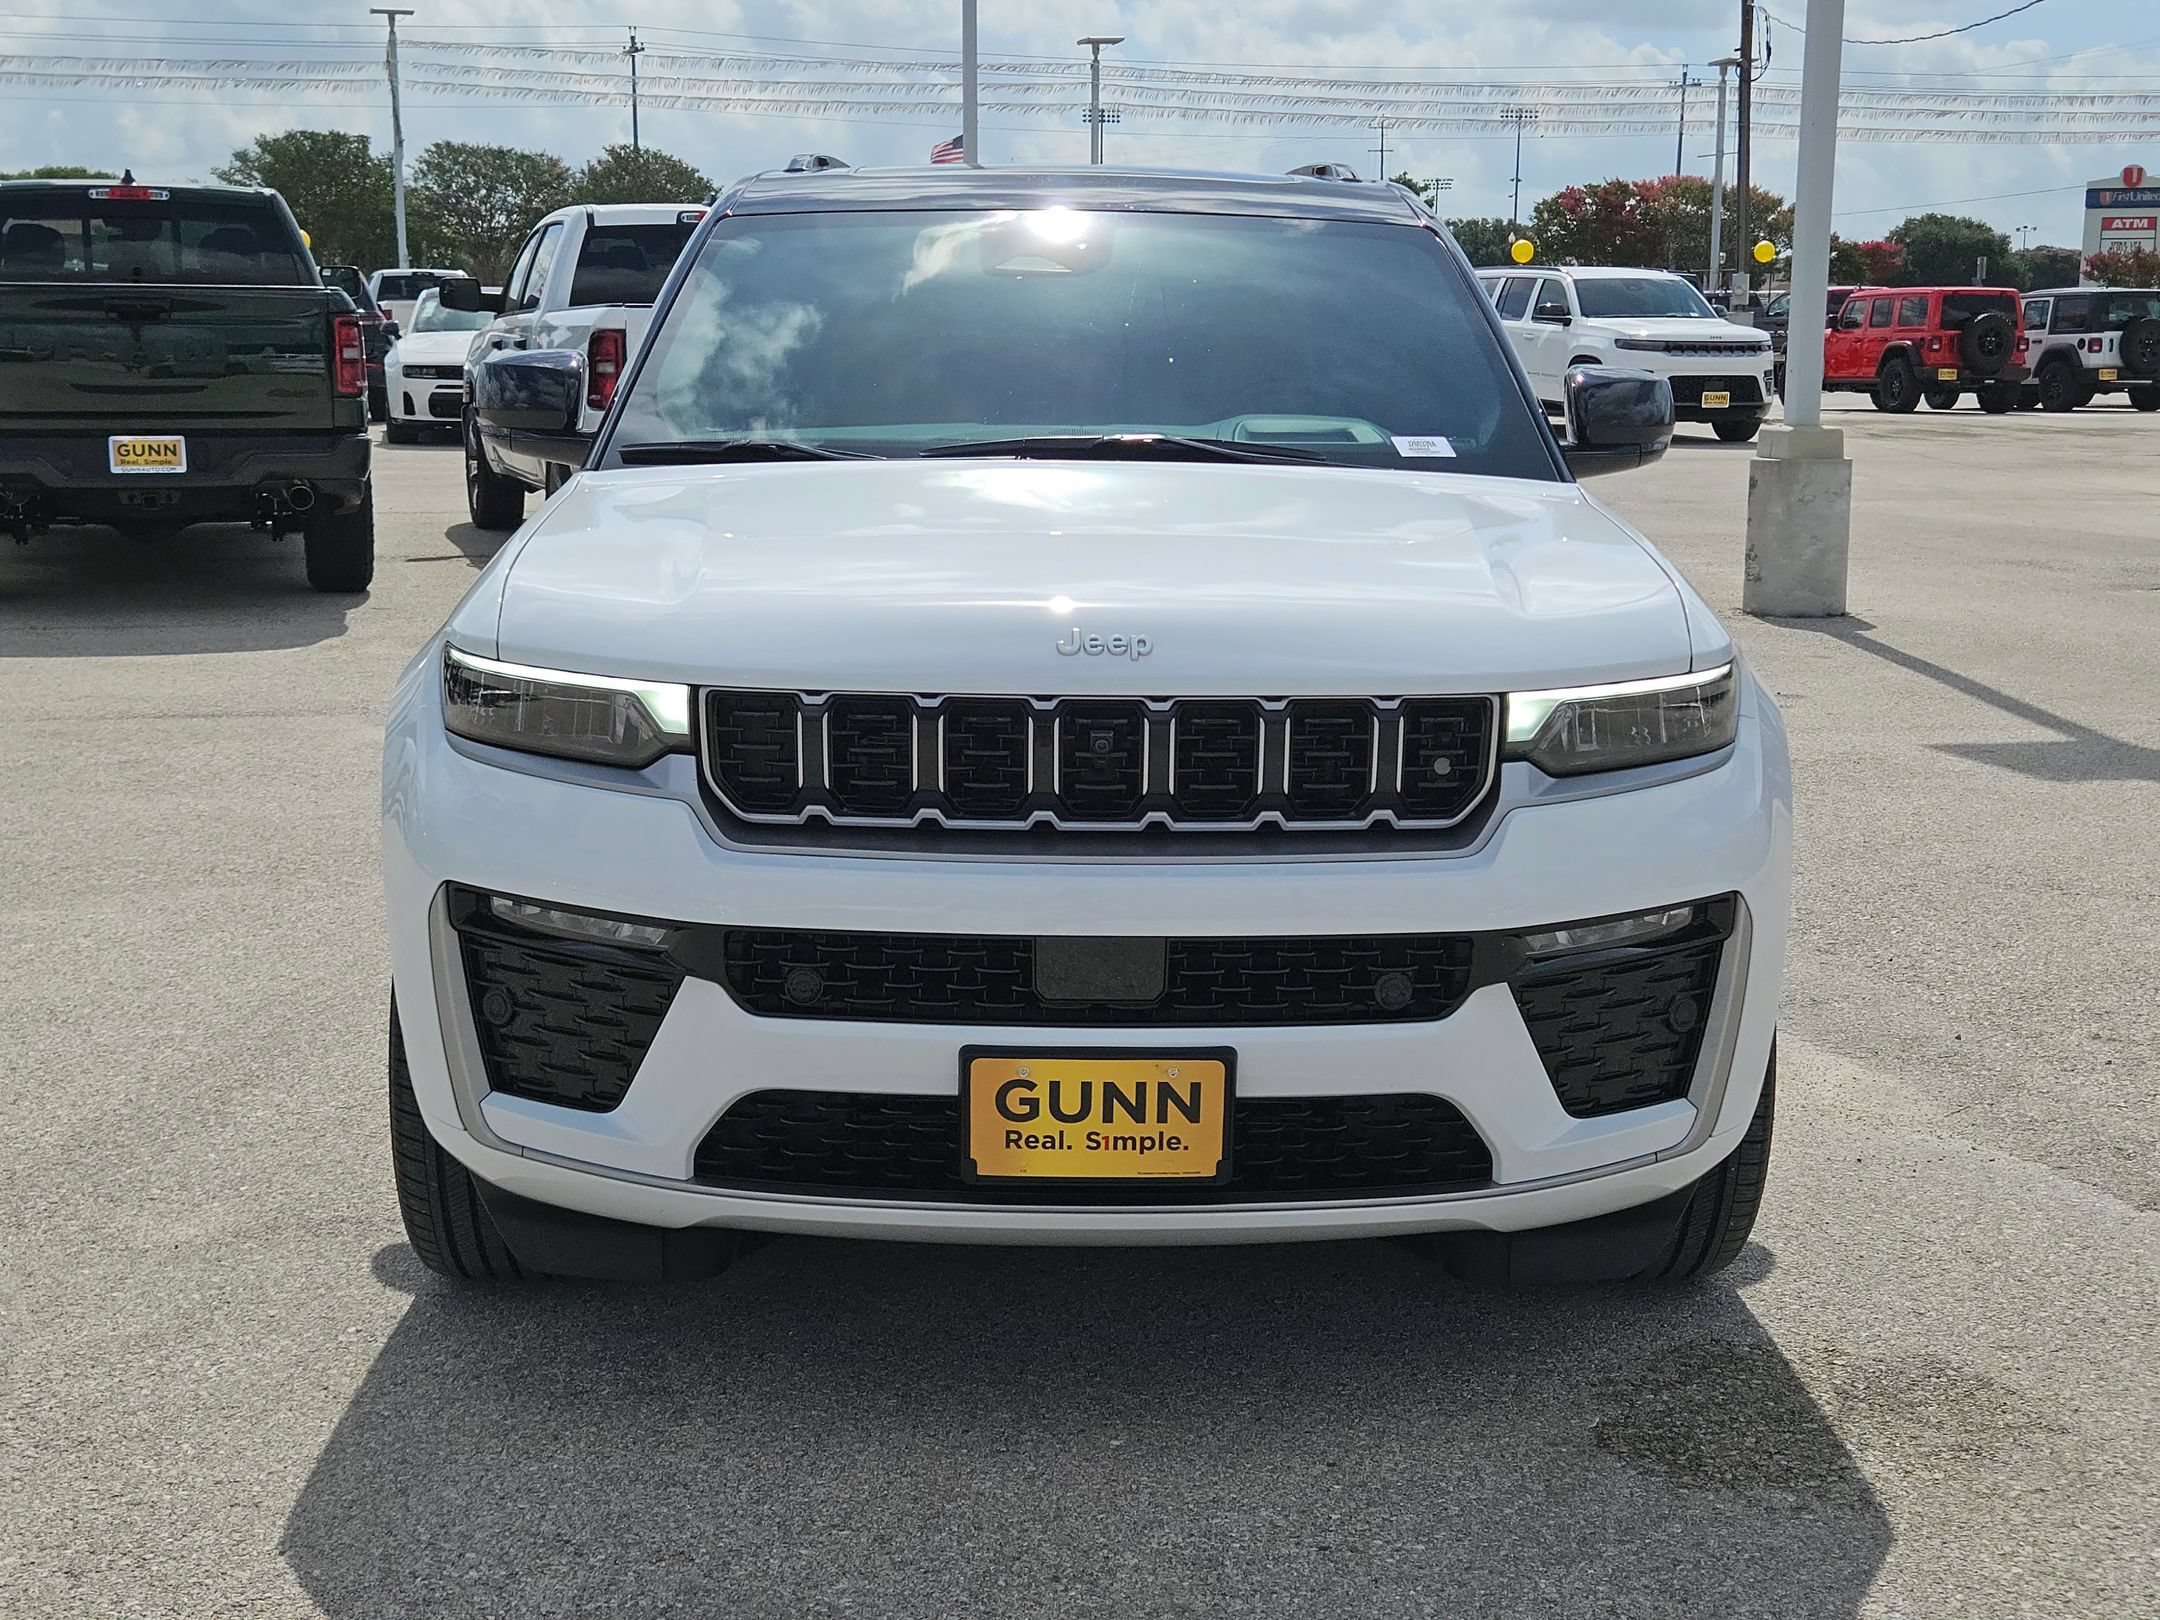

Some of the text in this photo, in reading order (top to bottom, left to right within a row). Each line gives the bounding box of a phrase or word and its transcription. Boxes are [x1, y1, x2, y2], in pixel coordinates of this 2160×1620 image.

[2111, 219, 2149, 229] ATM
[117, 444, 177, 457] GUNN
[1056, 627, 1154, 661] Jeep
[994, 1078, 1202, 1124] GUNN
[1005, 1130, 1073, 1150] Real.
